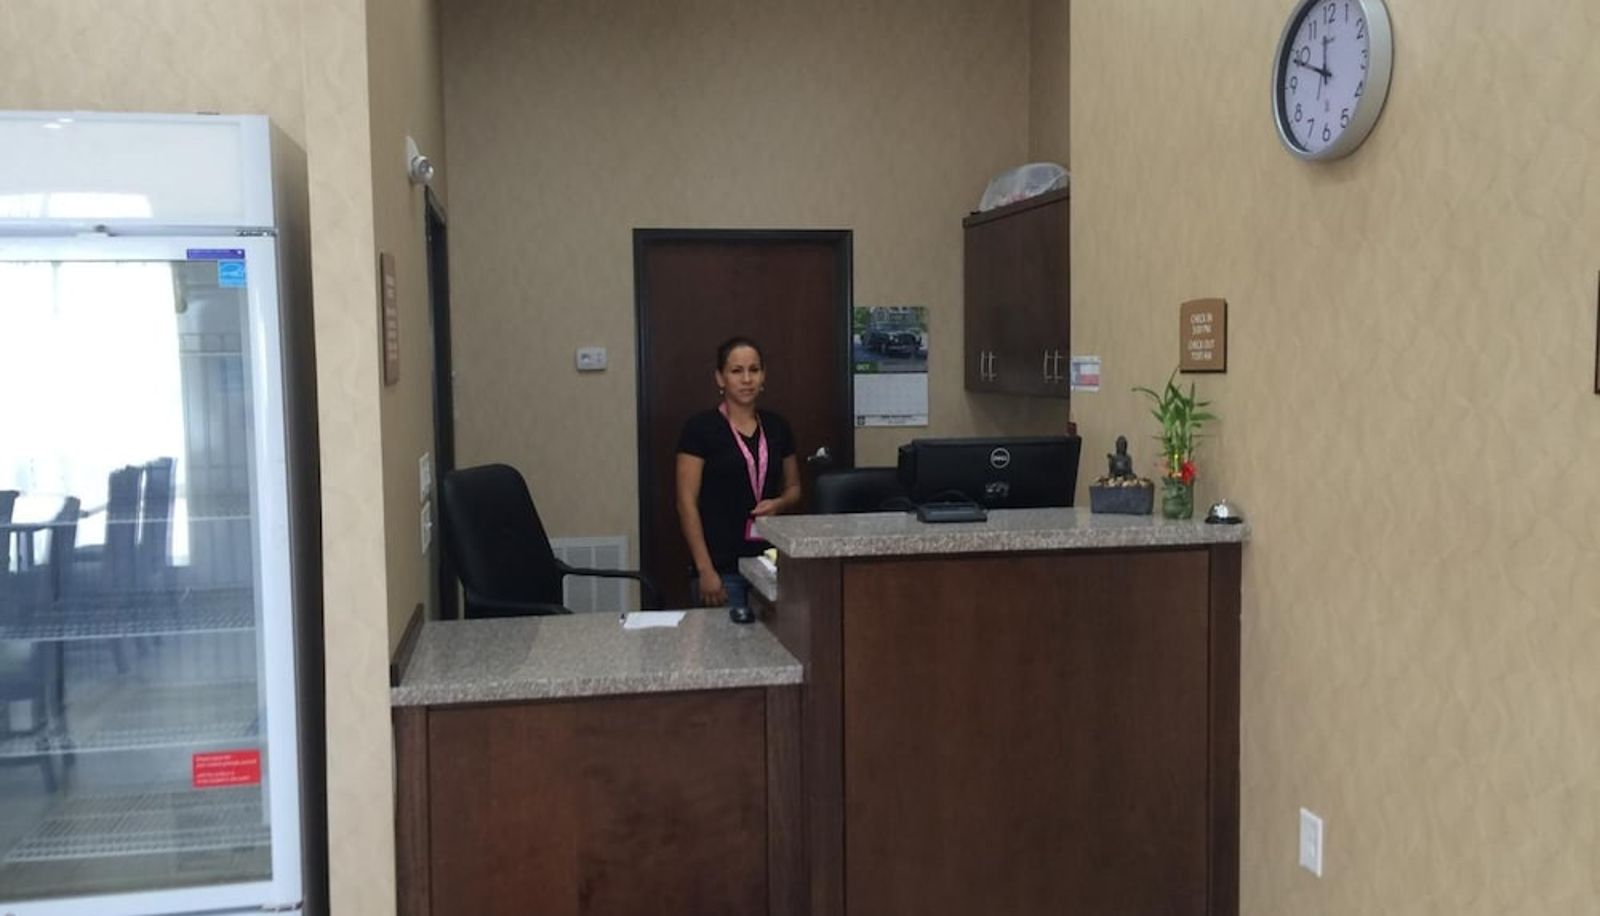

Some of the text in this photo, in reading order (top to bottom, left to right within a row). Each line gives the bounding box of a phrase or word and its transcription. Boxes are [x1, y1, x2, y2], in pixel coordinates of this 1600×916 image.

[1322, 2, 1336, 25] 12
[1344, 3, 1349, 23] 1
[1308, 19, 1317, 41] 11
[1356, 17, 1364, 40] 2
[1361, 49, 1368, 70] 3
[1290, 76, 1298, 95] 9
[1354, 80, 1363, 98] 4
[1294, 103, 1303, 123] 8
[1340, 108, 1349, 129] 5
[1307, 117, 1315, 139] 7
[1322, 123, 1331, 142] 6
[1190, 313, 1206, 324] CHECK
[1188, 339, 1215, 350] CHECK OUT
